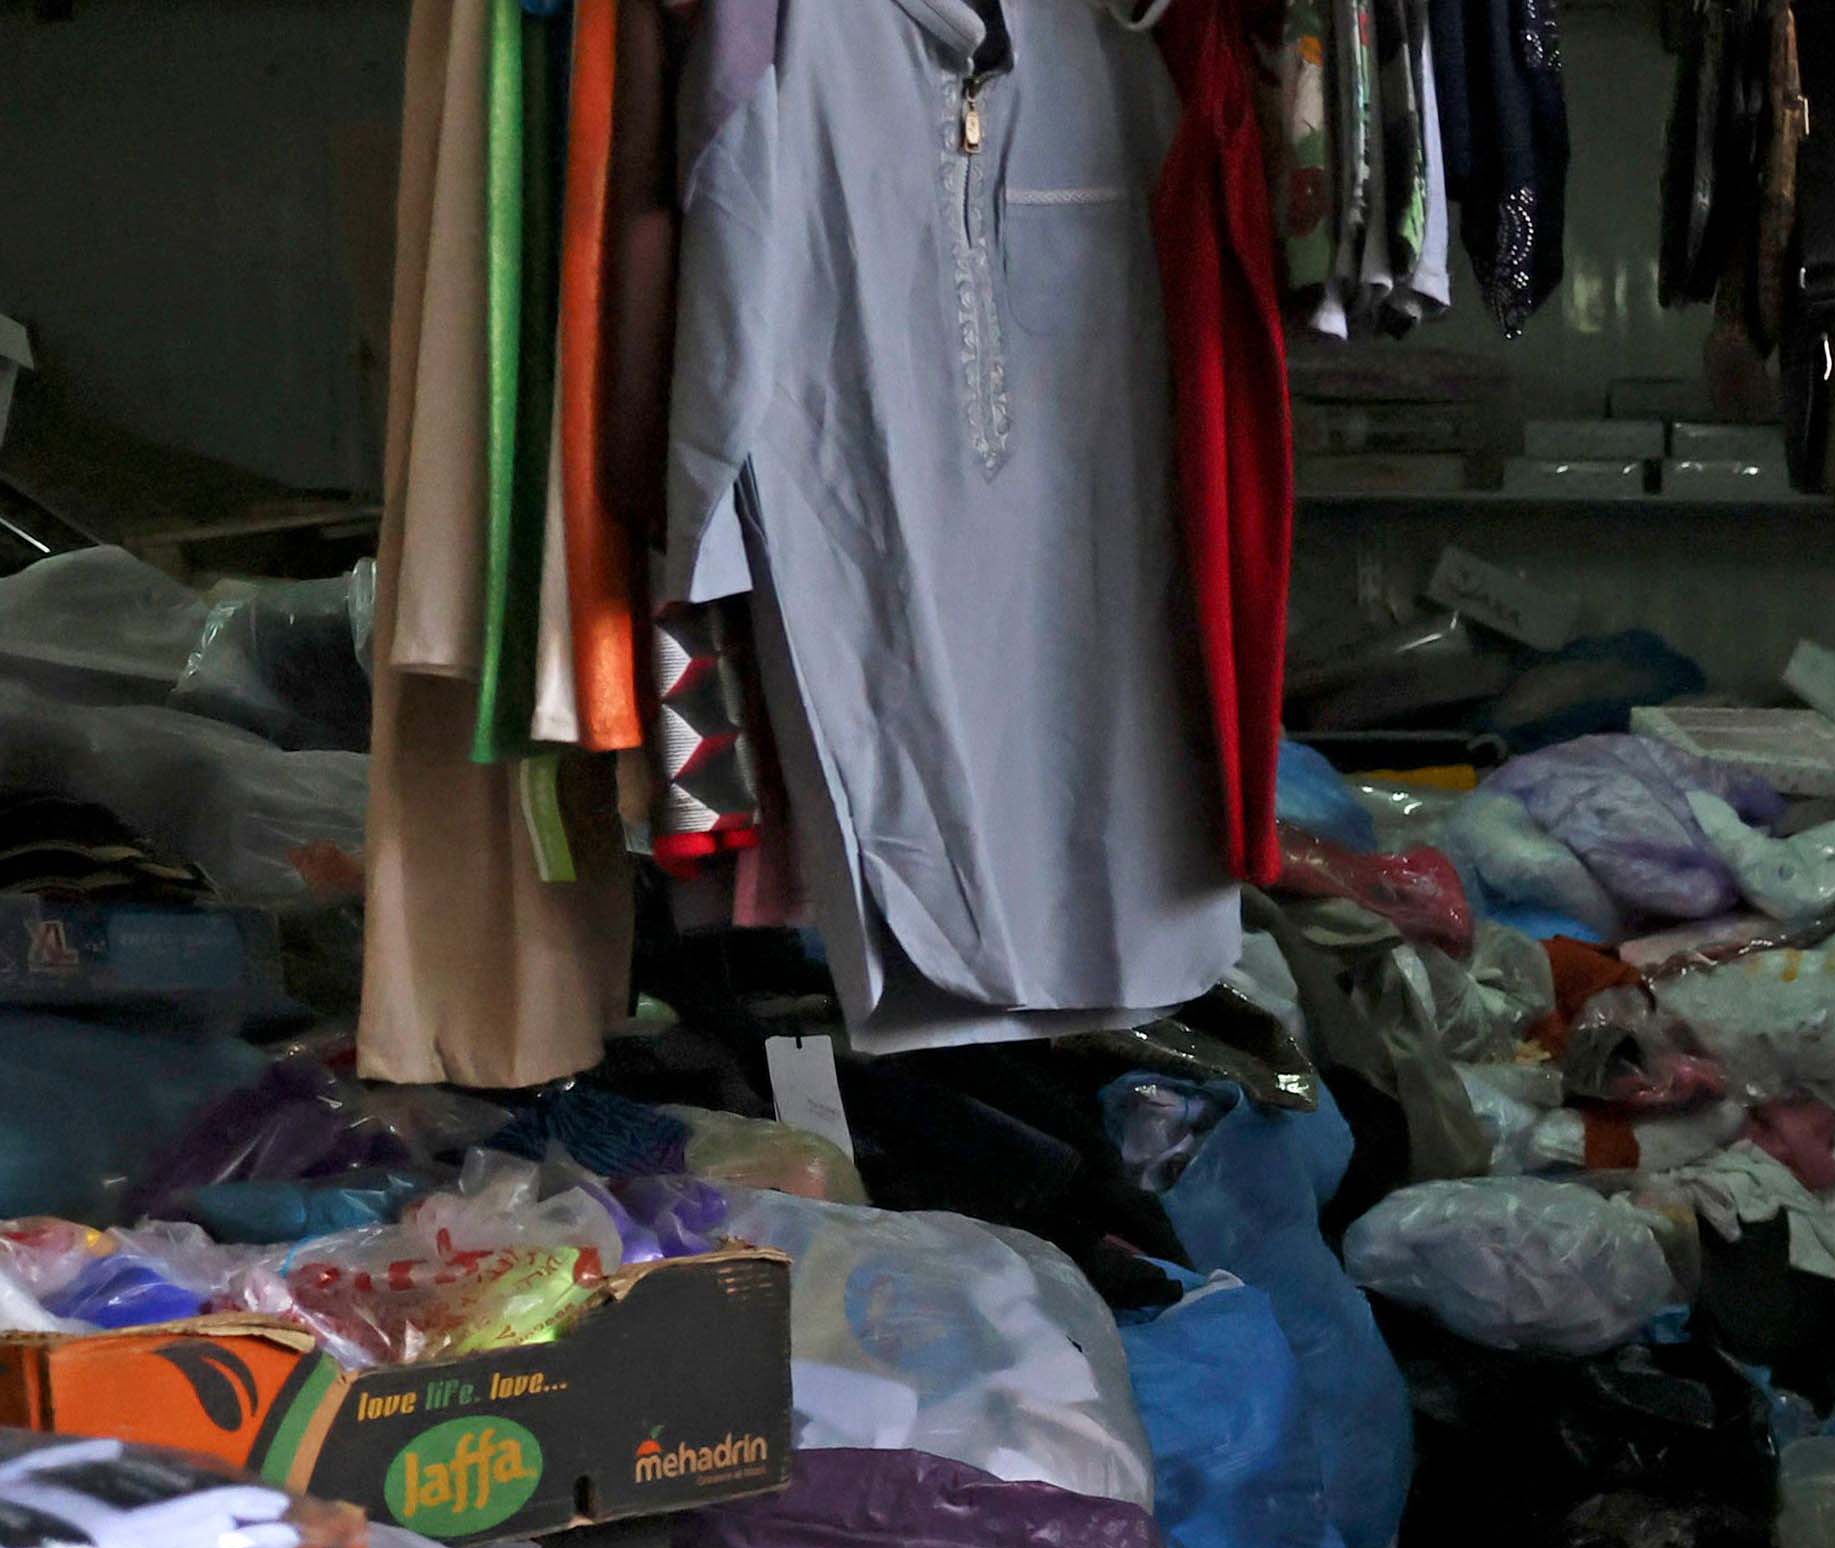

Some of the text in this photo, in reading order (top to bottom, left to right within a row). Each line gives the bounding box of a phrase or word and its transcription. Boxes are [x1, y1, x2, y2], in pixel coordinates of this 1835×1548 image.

[357, 1370, 569, 1422] love life. love...
[634, 1431, 769, 1485] mehadrin
